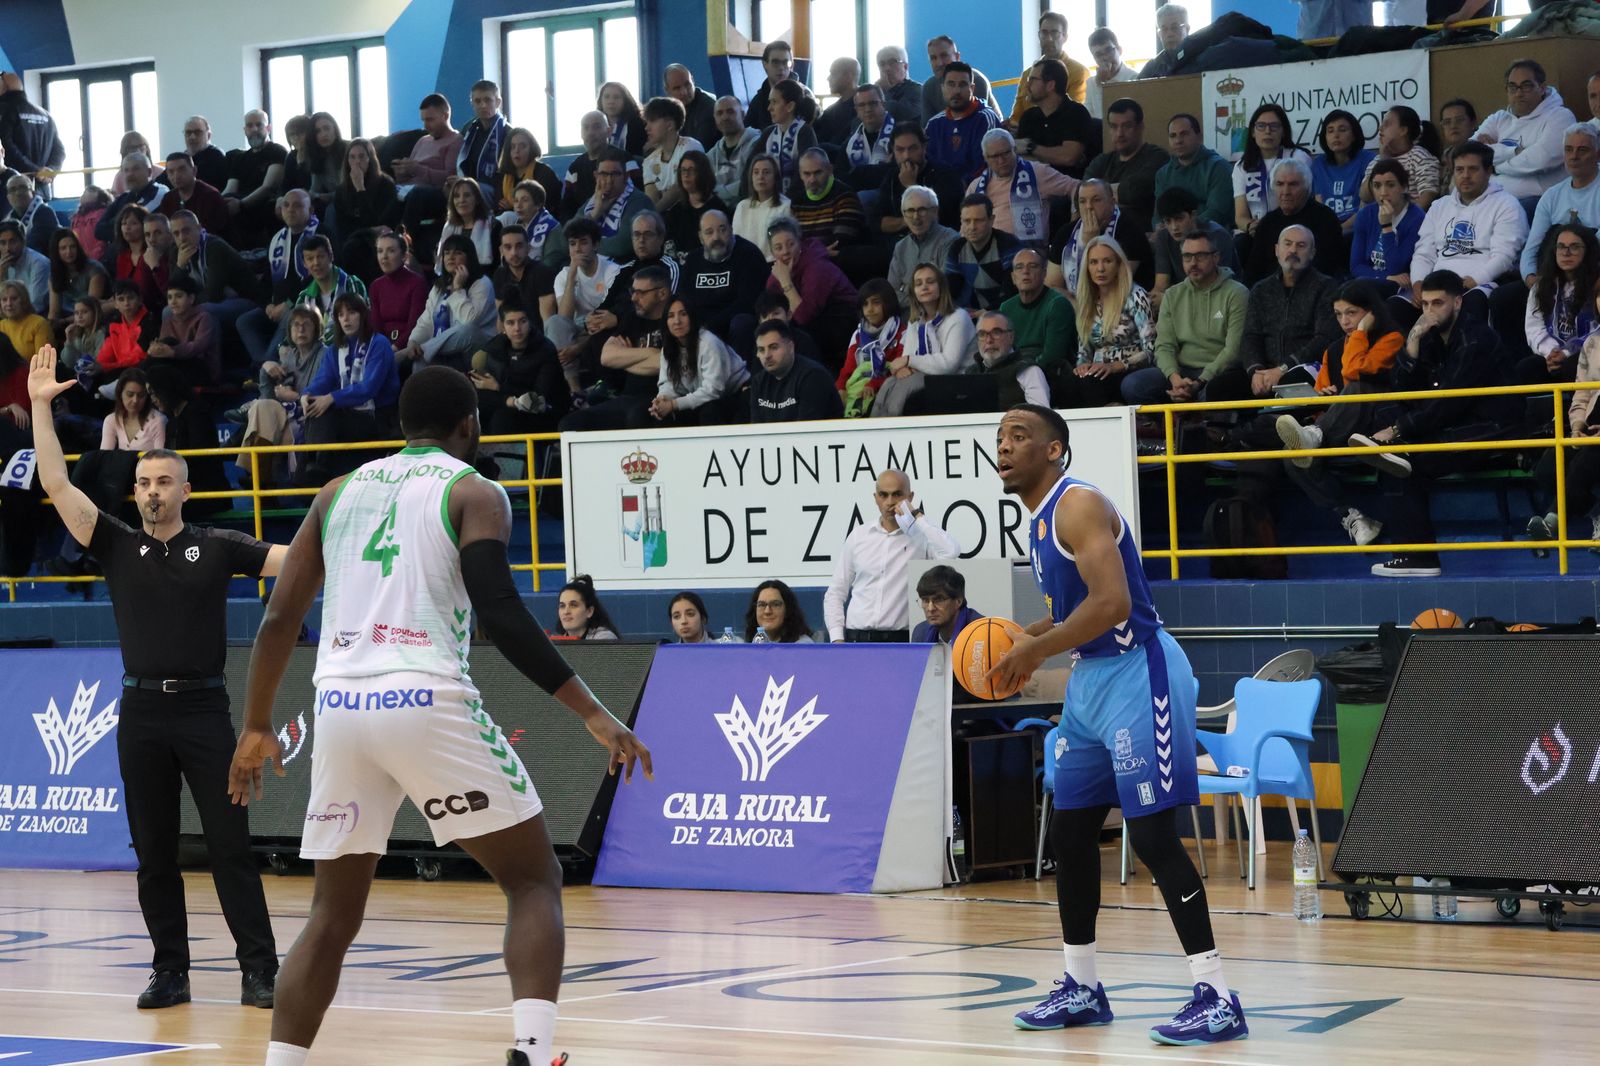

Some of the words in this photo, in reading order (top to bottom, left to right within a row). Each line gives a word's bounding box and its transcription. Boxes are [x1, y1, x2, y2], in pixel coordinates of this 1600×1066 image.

[1259, 78, 1419, 112] AYUNTAMIENTO
[699, 275, 727, 287] Polo
[703, 440, 1072, 488] AYUNTAMIEN
[361, 502, 400, 577] 4
[704, 507, 768, 564] DE
[391, 627, 428, 639] Dputació
[0, 785, 37, 811] AJA
[41, 786, 119, 812] RURAL
[662, 792, 729, 822] CAJA
[734, 794, 831, 823] RURAL
[17, 815, 88, 834] ZAMORA
[671, 826, 702, 845] DE
[706, 827, 795, 848] ZAMORA
